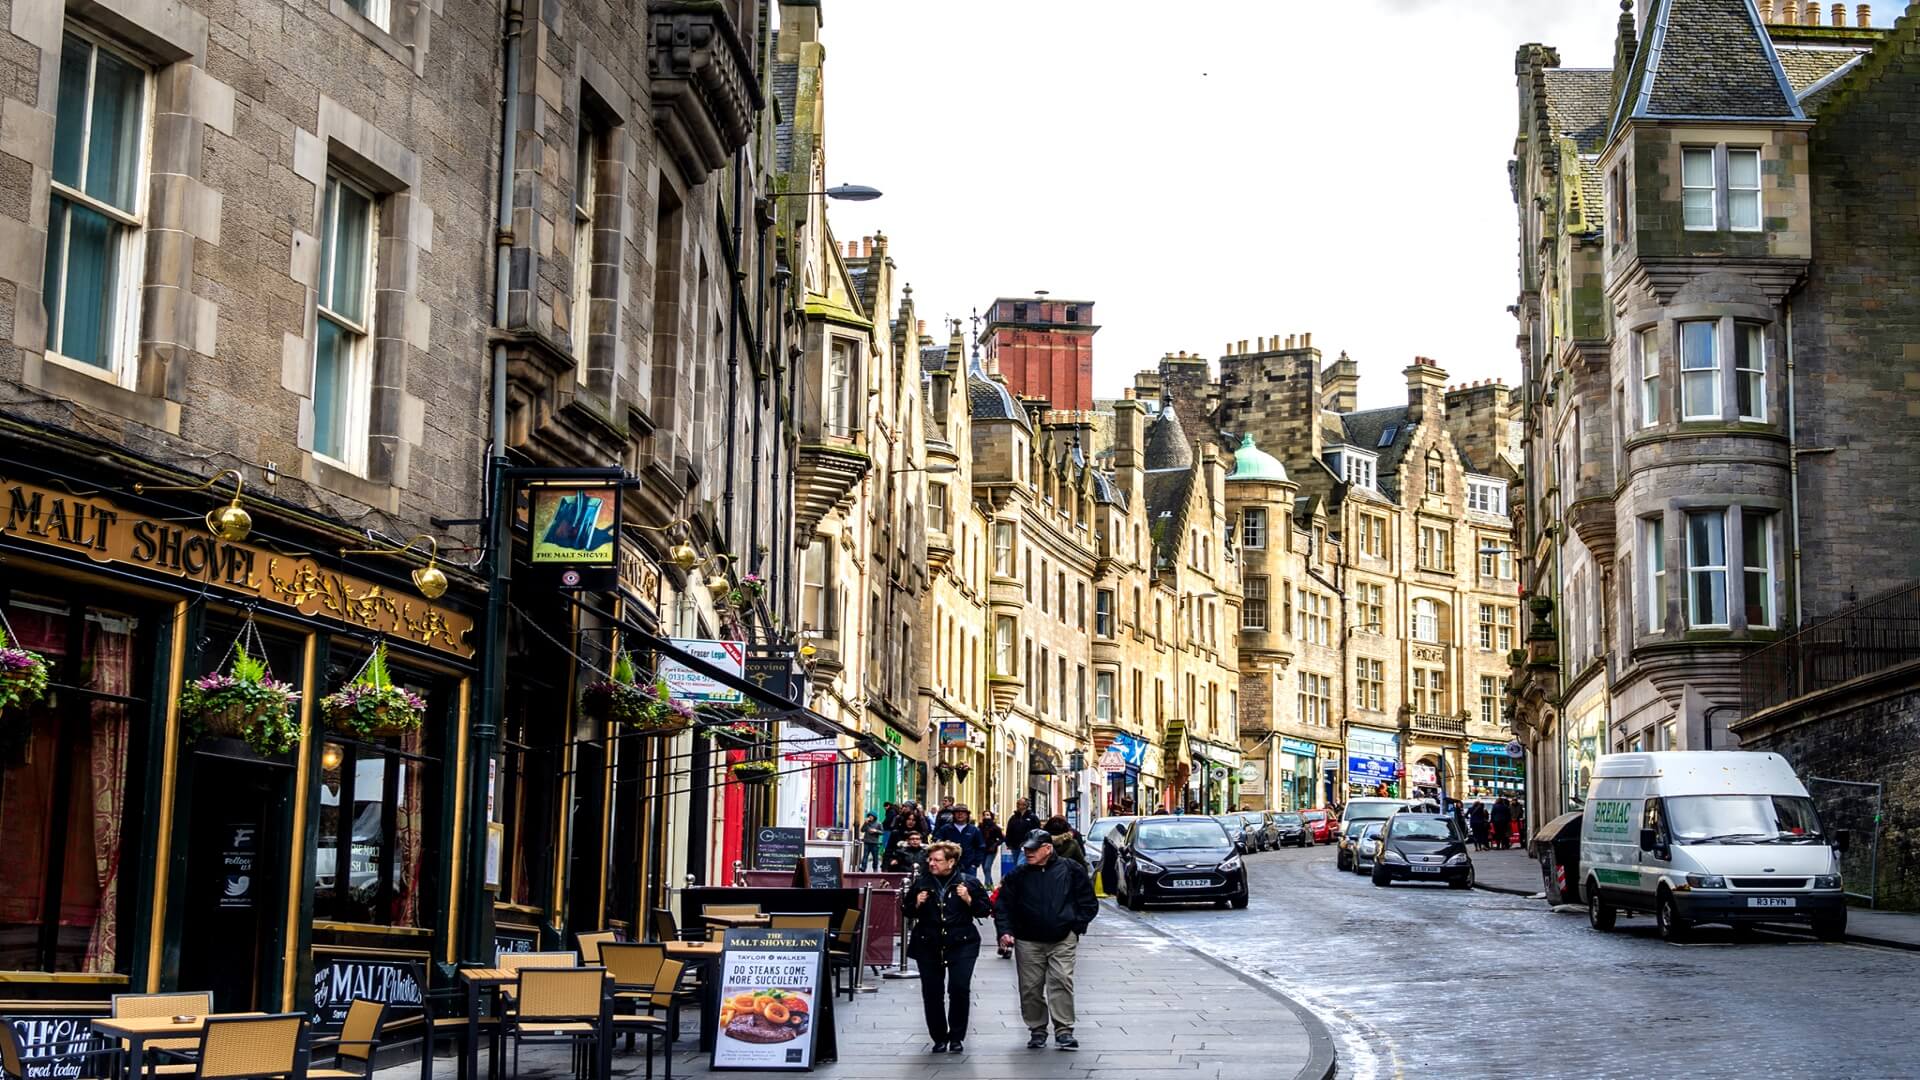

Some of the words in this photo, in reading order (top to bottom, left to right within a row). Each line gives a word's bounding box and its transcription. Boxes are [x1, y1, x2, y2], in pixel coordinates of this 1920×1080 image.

[7, 486, 118, 551] MALT
[131, 520, 262, 592] SHOVEL
[711, 651, 727, 660] Legal
[763, 663, 786, 671] vino
[1594, 802, 1631, 823] BREMAC
[1770, 898, 1787, 906] FYN
[734, 966, 745, 975] DO
[748, 966, 780, 975] STEAKS
[783, 966, 806, 975] COME
[330, 964, 394, 1002] MALT
[729, 976, 751, 985] MORE
[755, 976, 808, 985] SUCCULENT?
[53, 1062, 82, 1080] today
